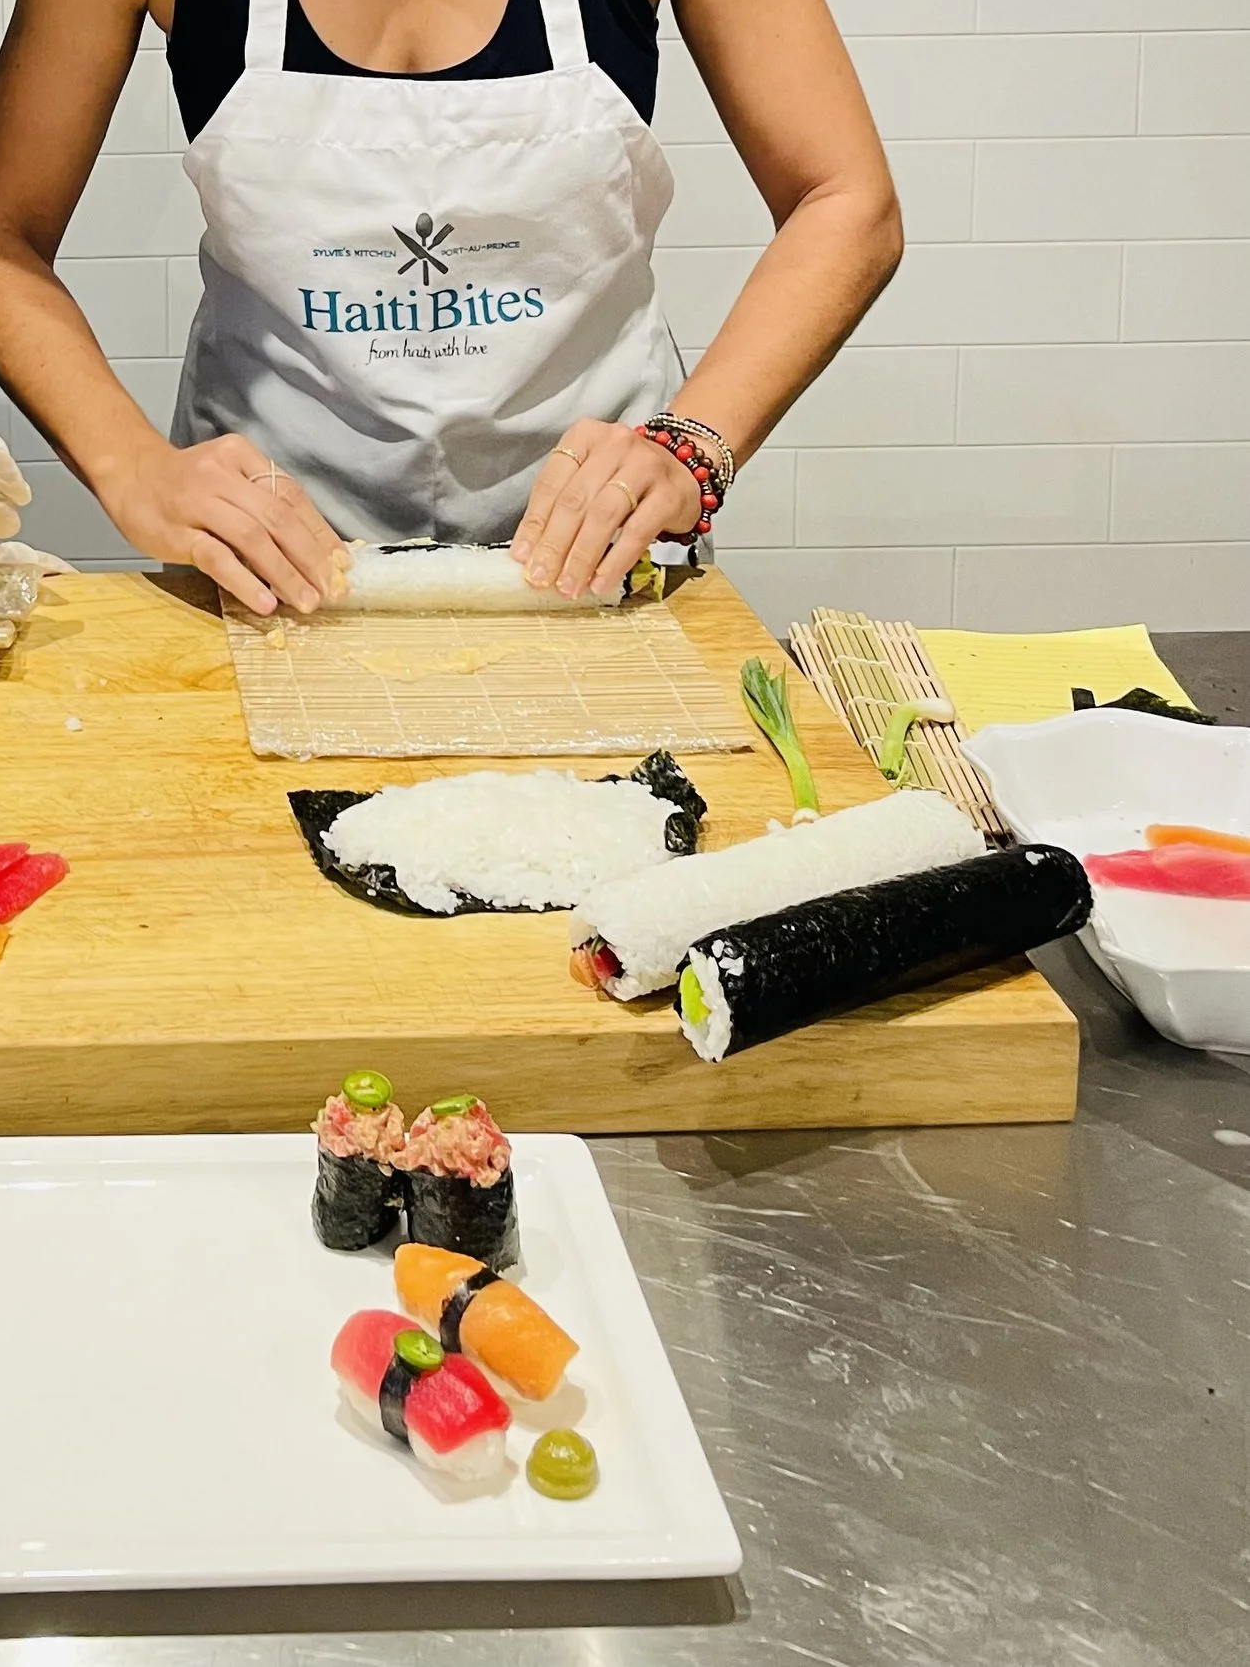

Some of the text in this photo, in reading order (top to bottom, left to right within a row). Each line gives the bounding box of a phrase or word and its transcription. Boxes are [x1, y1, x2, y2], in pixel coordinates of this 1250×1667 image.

[312, 247, 397, 258] SYLVIE'S KITCHEN
[441, 241, 521, 257] PORT-AU-PRINCE
[365, 338, 399, 366] from
[434, 335, 460, 358] with
[464, 335, 488, 355] love
